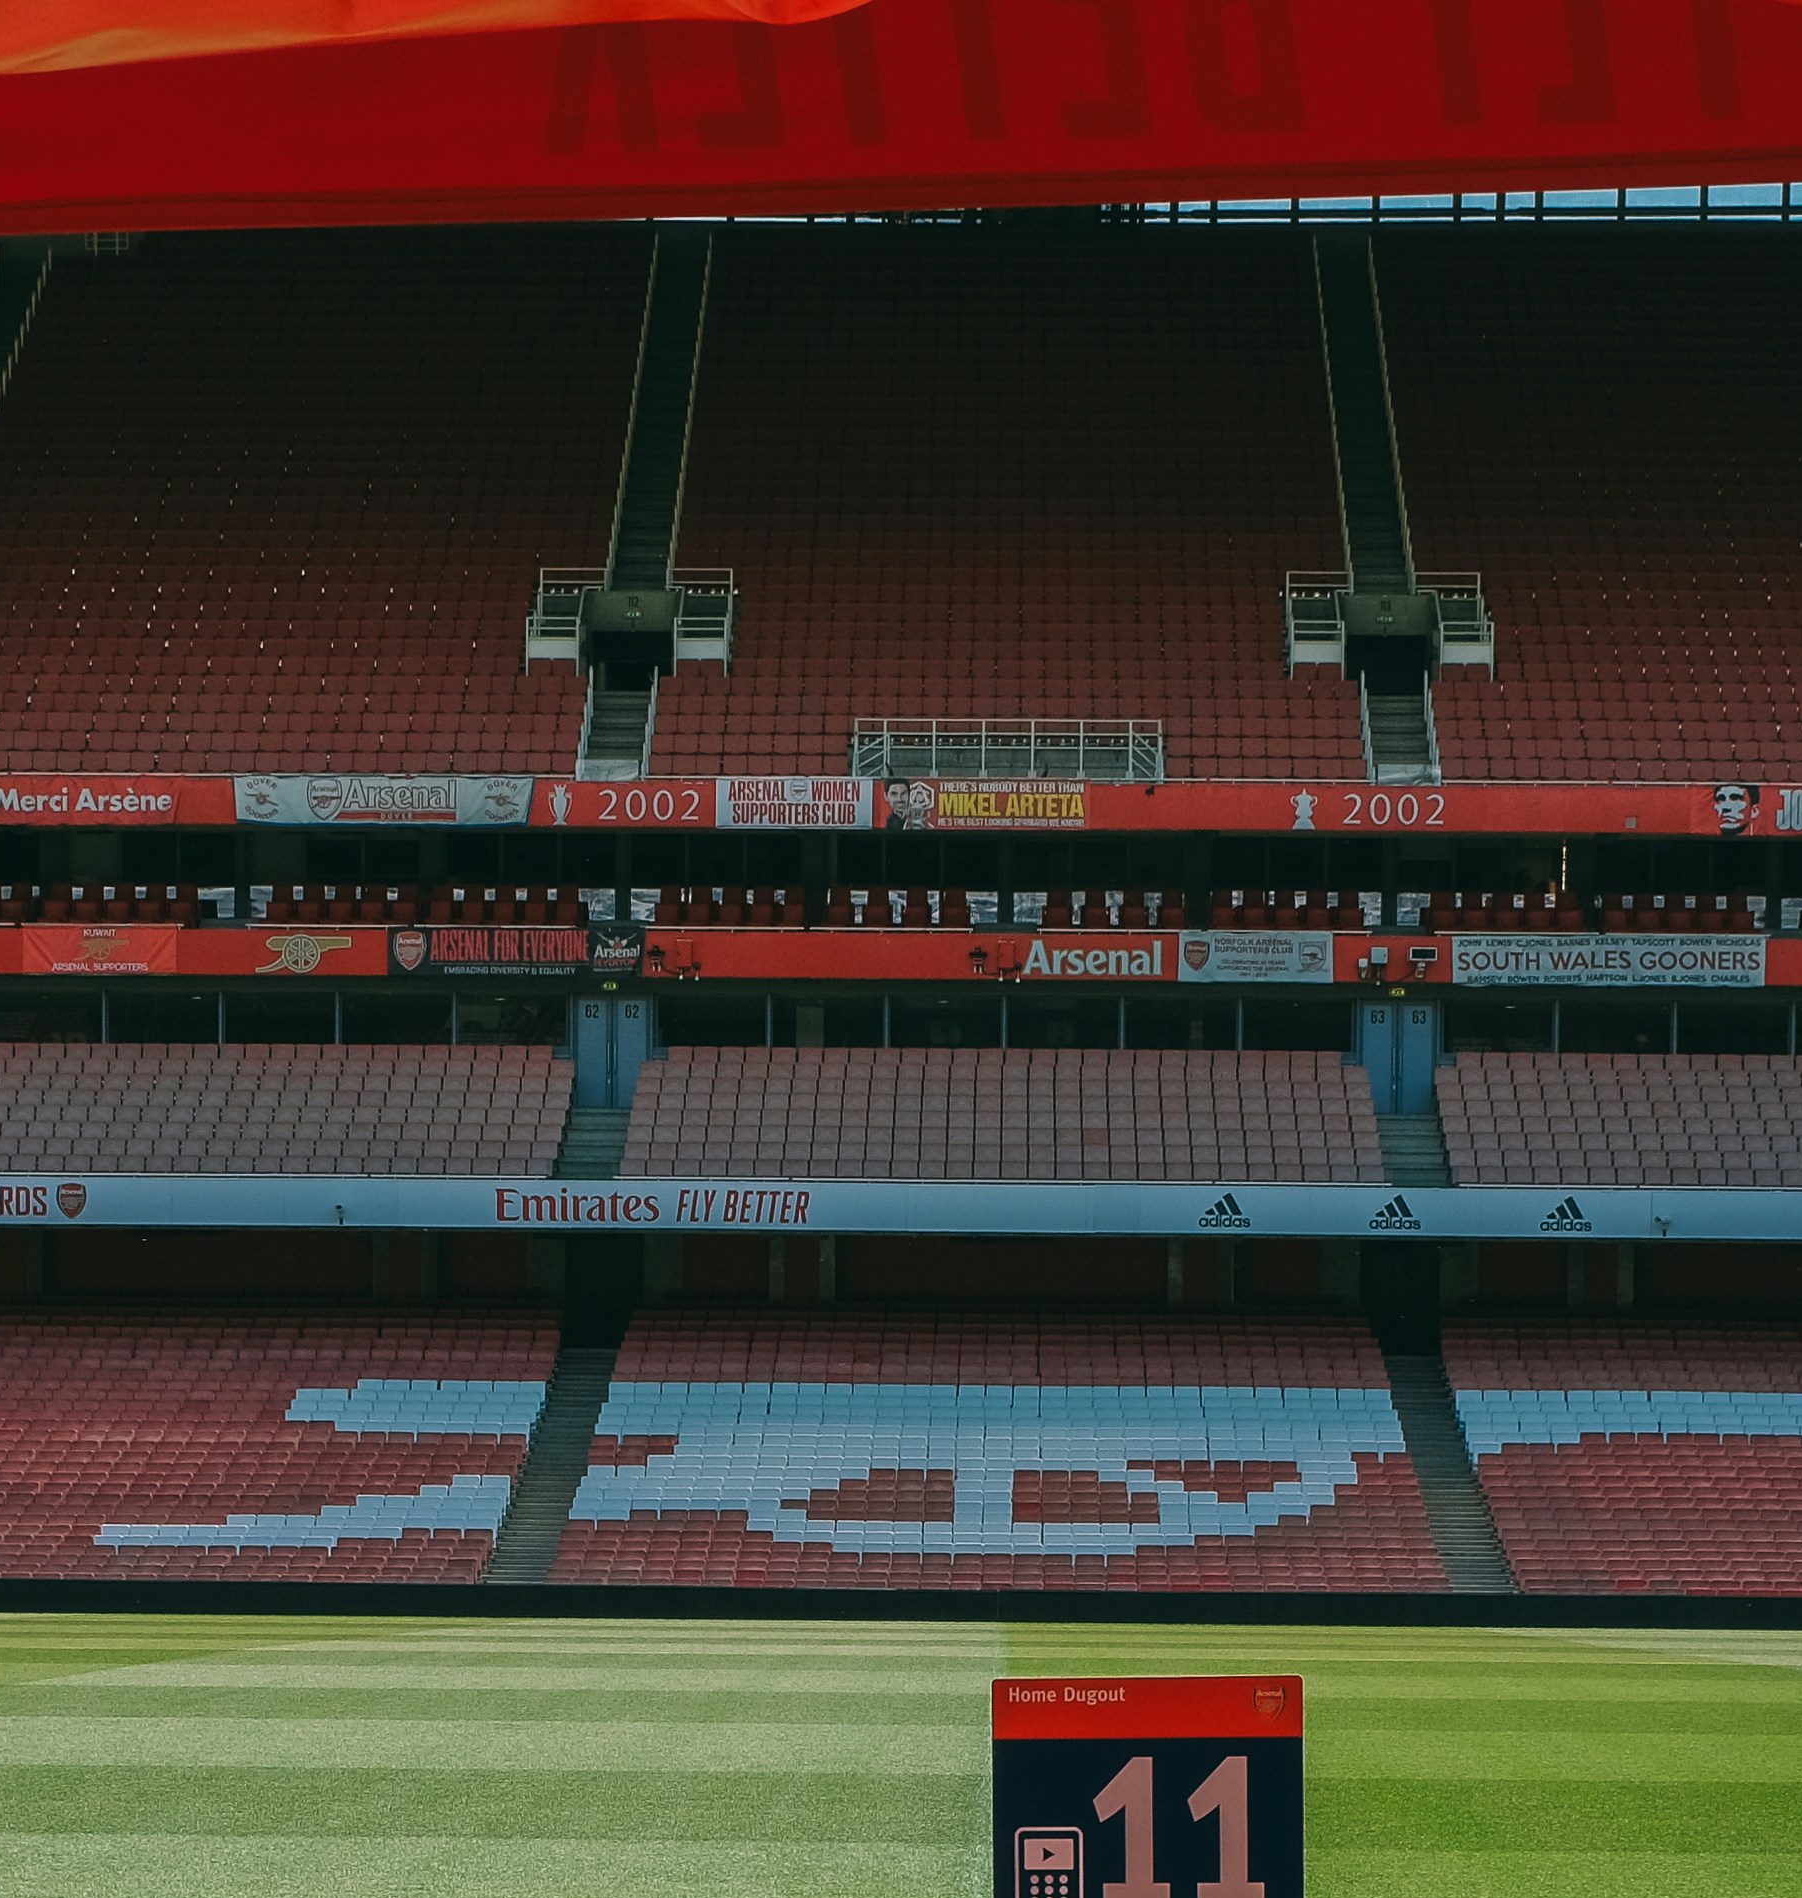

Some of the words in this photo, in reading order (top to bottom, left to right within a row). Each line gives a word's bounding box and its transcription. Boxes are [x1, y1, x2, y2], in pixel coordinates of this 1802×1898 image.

[246, 777, 278, 790] DOVER
[486, 779, 519, 792] DOVER
[939, 781, 977, 793] THERE'S
[978, 781, 1018, 793] NOBODY
[1019, 781, 1056, 793] BETTER
[1058, 781, 1085, 794] THAN
[342, 778, 457, 811] Arsenal
[728, 780, 787, 802] ARSENAL
[811, 780, 861, 803] WOMEN
[74, 787, 173, 814] Arsène
[597, 790, 700, 821] 2002
[938, 793, 1001, 818] MIKEL
[1005, 794, 1085, 818] ARTETA
[380, 812, 413, 820] DOVER
[732, 803, 820, 825] SUPPORTERS
[822, 803, 856, 825] CLUB
[1343, 793, 1445, 826] 2002
[430, 930, 491, 961] ARSENAL
[493, 930, 520, 961] FOR
[522, 930, 590, 961] EVERYONE
[1214, 938, 1254, 946] NORFOLK
[1457, 939, 1482, 947] JOHN
[1485, 938, 1512, 947] LEWIS
[1556, 938, 1591, 947] BARNES
[1594, 937, 1627, 946] KELSEY
[1631, 938, 1675, 947] TAPSCOTT
[1679, 938, 1713, 947] BOWEN
[1716, 938, 1762, 947] NICHOLAS
[593, 944, 641, 959] Arsenal
[1214, 946, 1270, 954] SUPPORTERS
[1271, 946, 1294, 954] CLUB
[1023, 939, 1162, 977] Arsenal
[1457, 951, 1541, 972] SOUTH
[1548, 950, 1632, 971] WALES
[1639, 951, 1761, 971] GOONERS
[51, 962, 91, 972] ARSENAL
[93, 962, 149, 972] SUPPORTERS
[538, 967, 576, 975] EQUALITY
[1507, 974, 1540, 984] BOWEN
[1585, 973, 1628, 982] HARTSON
[1710, 974, 1751, 983] CHARLES
[584, 1004, 599, 1019] 62
[624, 1004, 639, 1019] 62
[1370, 1010, 1385, 1024] 63
[1411, 1010, 1427, 1024] 63
[494, 1187, 660, 1224] Emirates
[675, 1188, 717, 1224] FLY
[722, 1189, 811, 1225] BETTER
[1198, 1214, 1252, 1229] adidas
[1369, 1216, 1422, 1231] adidas
[1539, 1217, 1593, 1233] adidas
[1008, 1686, 1057, 1703] Home
[1064, 1686, 1126, 1706] Dugout
